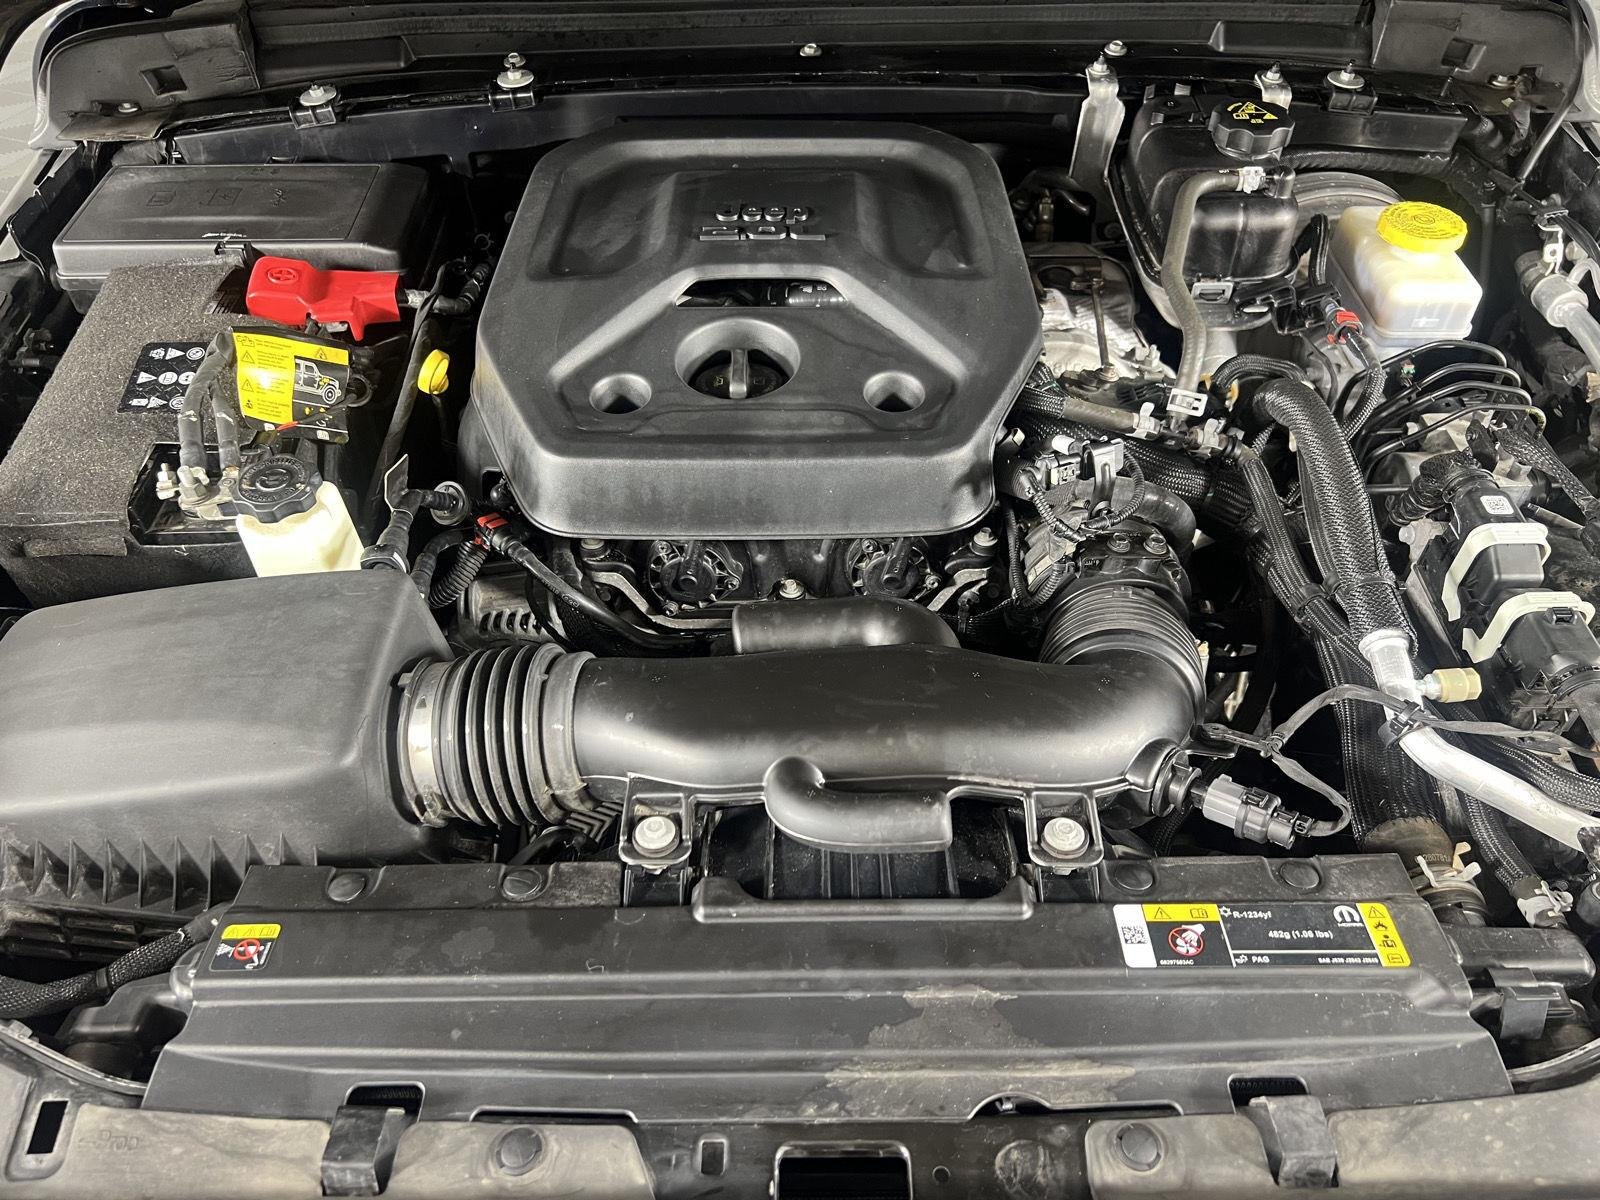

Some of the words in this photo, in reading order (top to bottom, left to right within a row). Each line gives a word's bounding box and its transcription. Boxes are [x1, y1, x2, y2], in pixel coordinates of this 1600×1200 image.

[714, 204, 808, 224] Jeep
[1232, 910, 1272, 920] R-1234yf
[1314, 930, 1334, 940] lbs)
[1251, 955, 1270, 963] PAG
